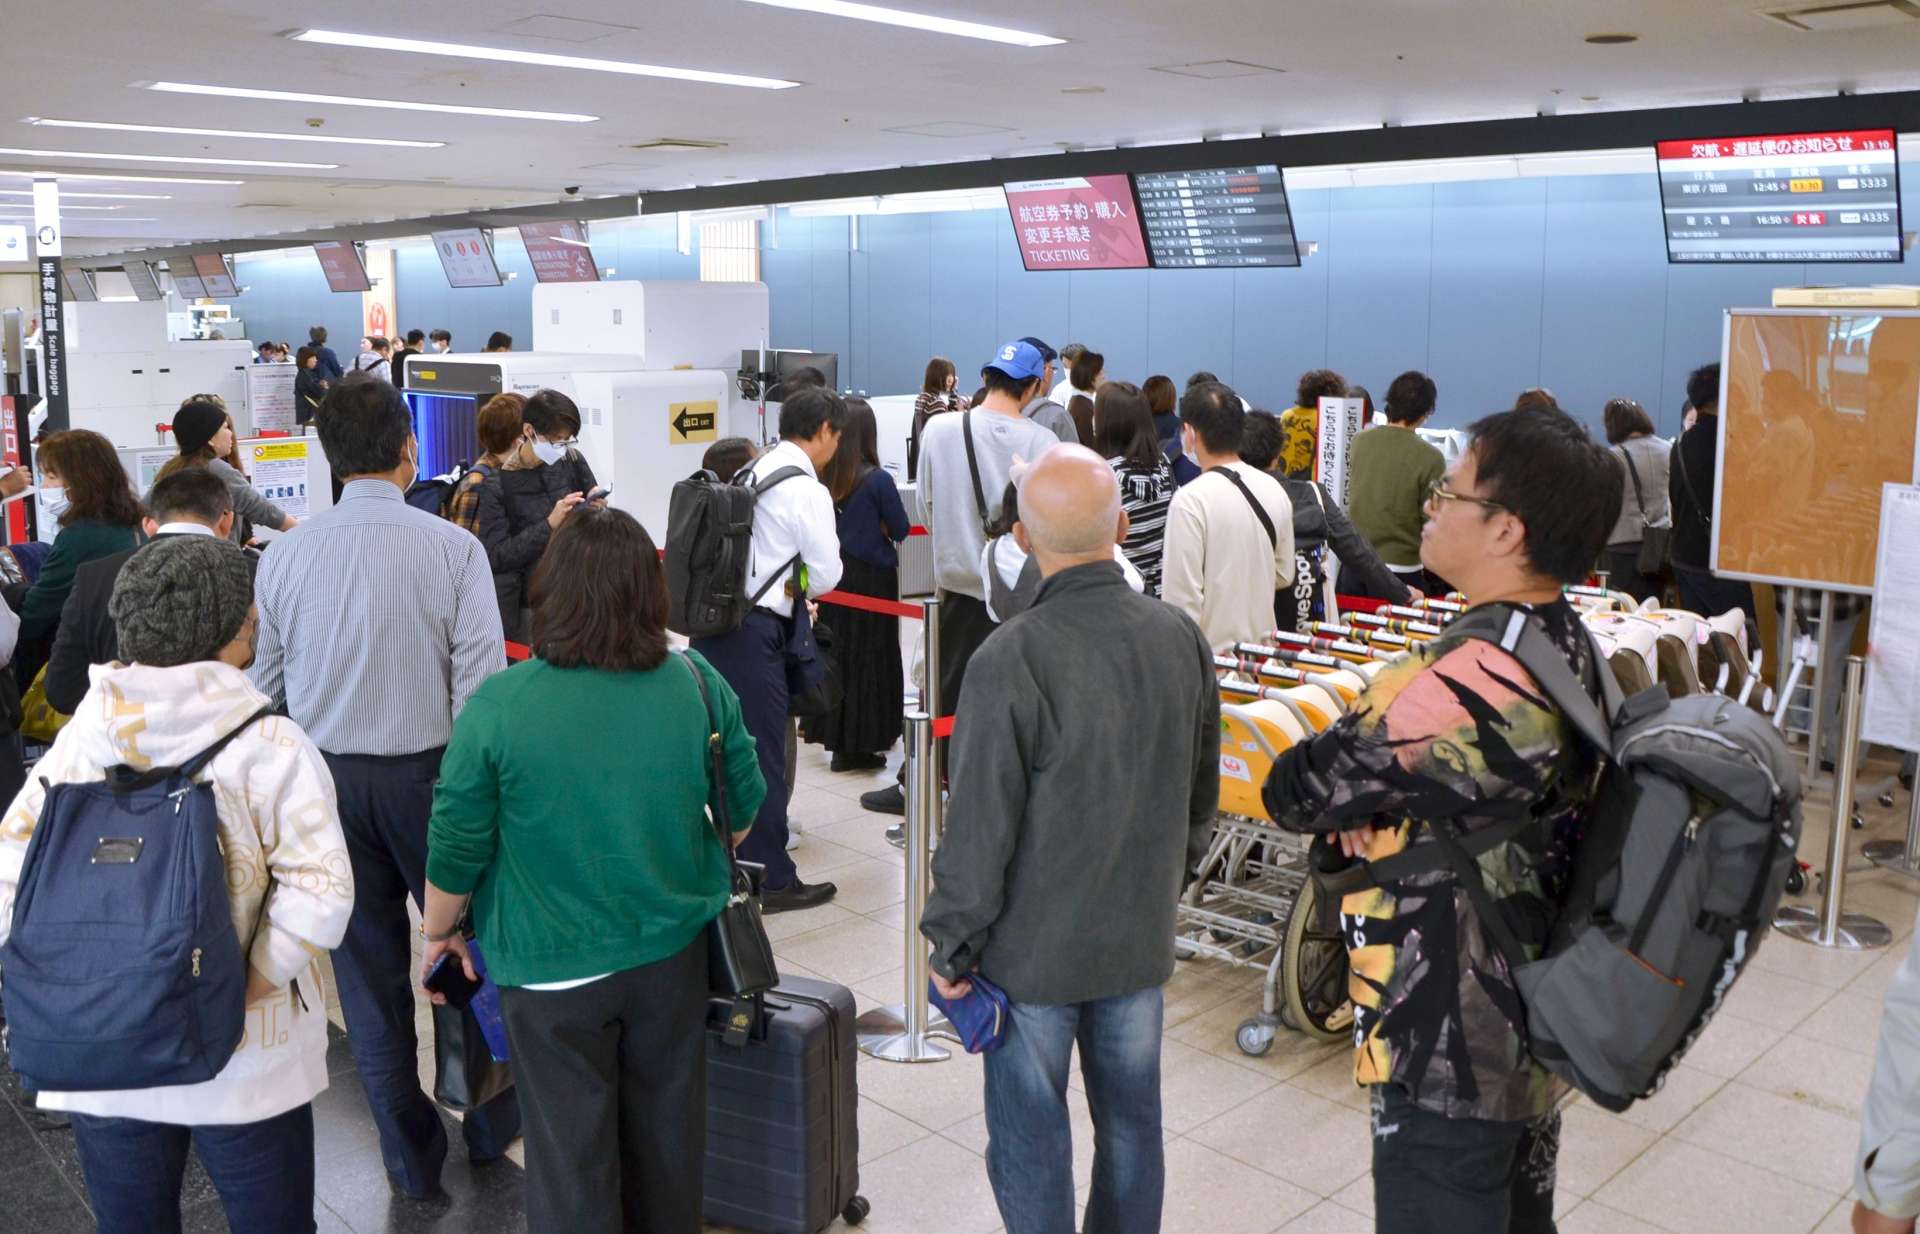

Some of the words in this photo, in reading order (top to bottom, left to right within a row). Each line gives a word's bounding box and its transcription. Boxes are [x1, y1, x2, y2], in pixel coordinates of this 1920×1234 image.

[1691, 137, 1853, 157] 欠航・遅延便のお知らせ
[1860, 178, 1888, 188] 5333
[1019, 201, 1126, 223] 航空券予約・購入
[1861, 213, 1890, 223] 4335
[1024, 225, 1091, 244] 変更手続き
[1030, 249, 1089, 263] TICKETING
[48, 335, 58, 357] Scale
[49, 358, 60, 396] baggage
[683, 417, 699, 428] 出口
